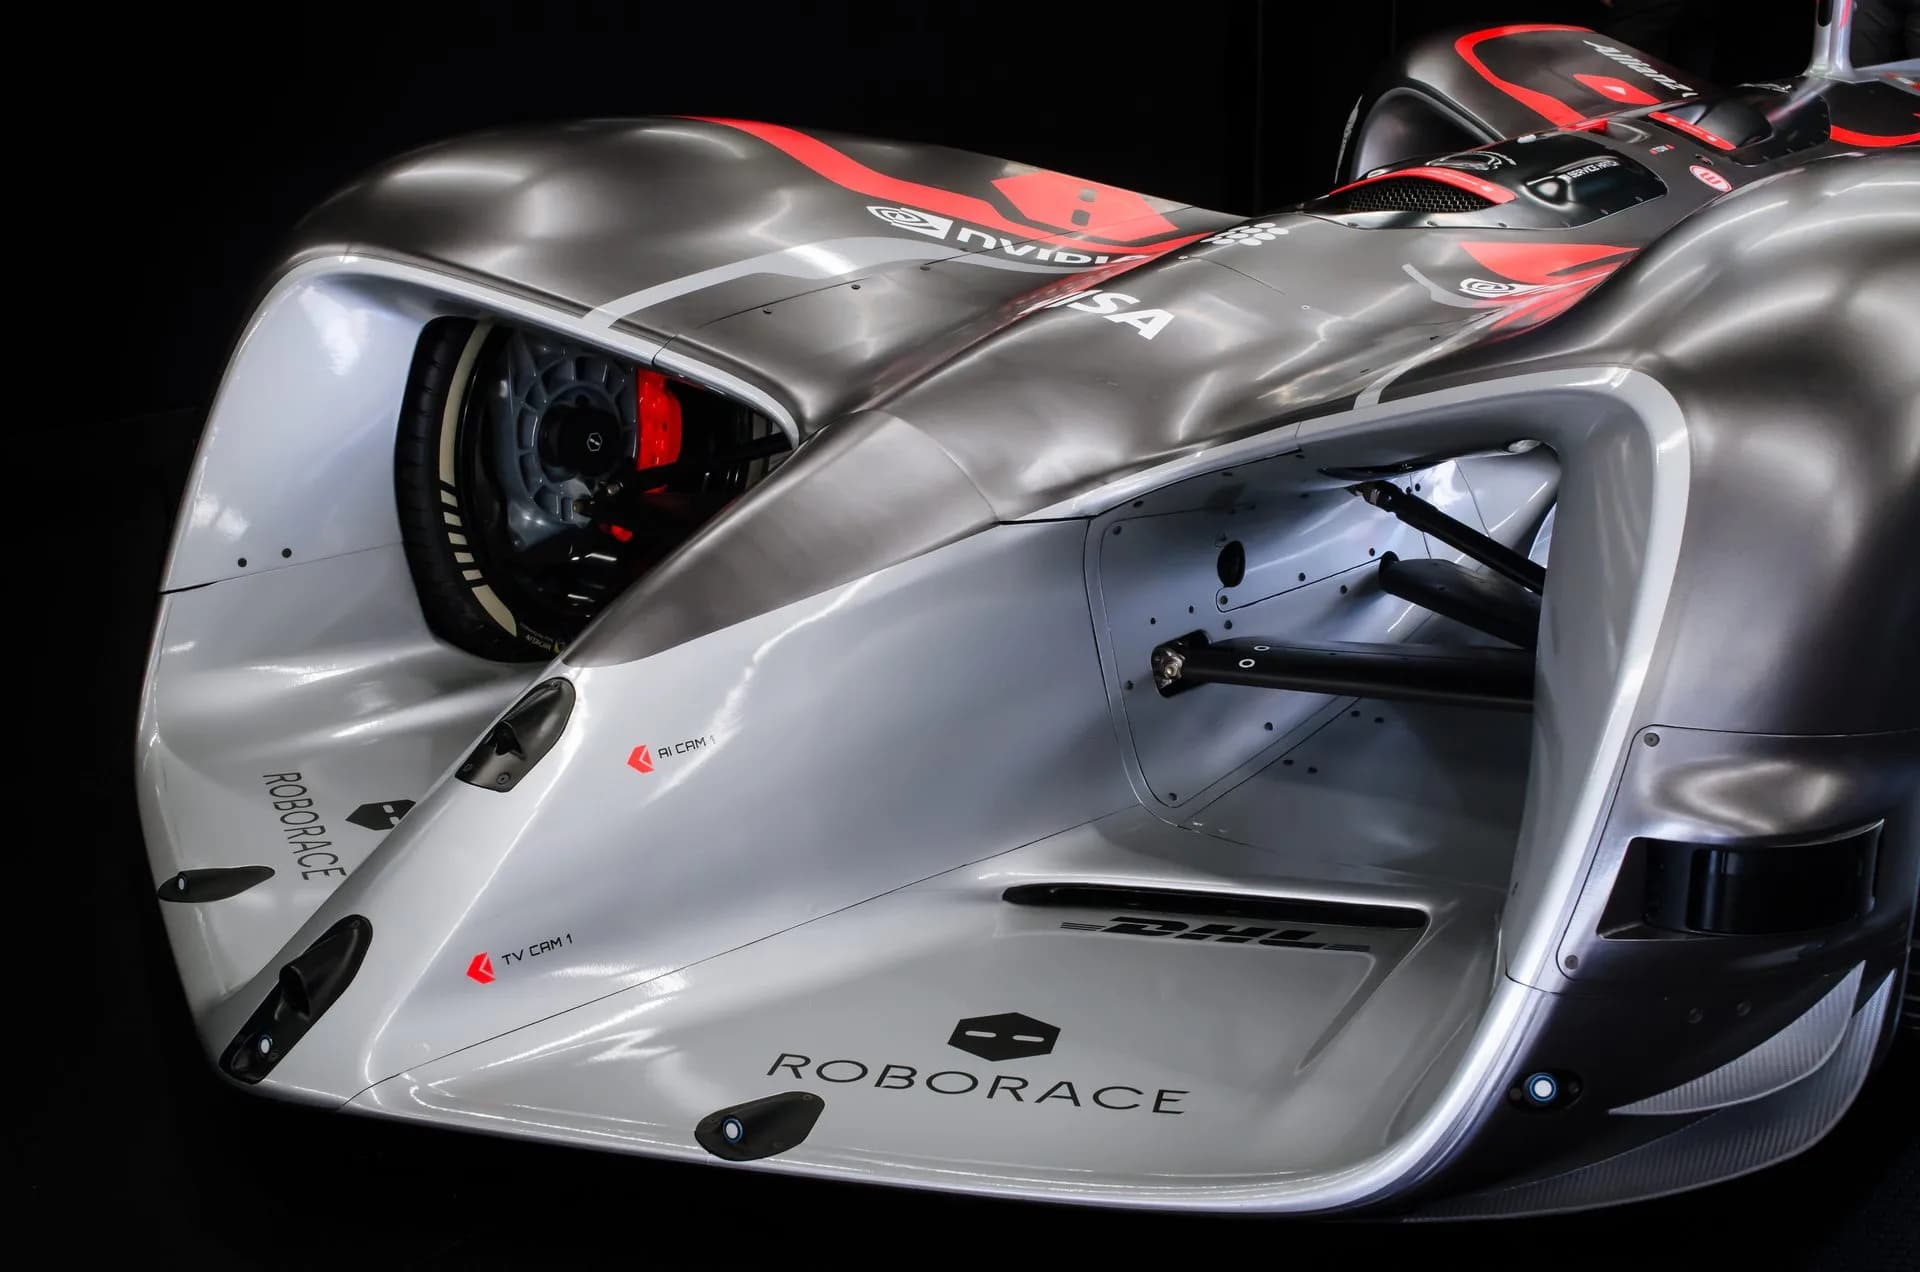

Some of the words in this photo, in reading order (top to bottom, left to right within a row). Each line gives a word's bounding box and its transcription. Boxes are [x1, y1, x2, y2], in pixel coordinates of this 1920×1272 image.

[1567, 164, 1600, 178] SERVICE
[658, 746, 672, 758] AI
[675, 736, 706, 754] CAM
[262, 772, 347, 880] ROBORACE
[501, 949, 524, 965] TV
[529, 937, 562, 956] CAM
[566, 933, 573, 944] 1
[1100, 915, 1328, 950] DHL
[766, 1053, 1192, 1115] ROBORACE
